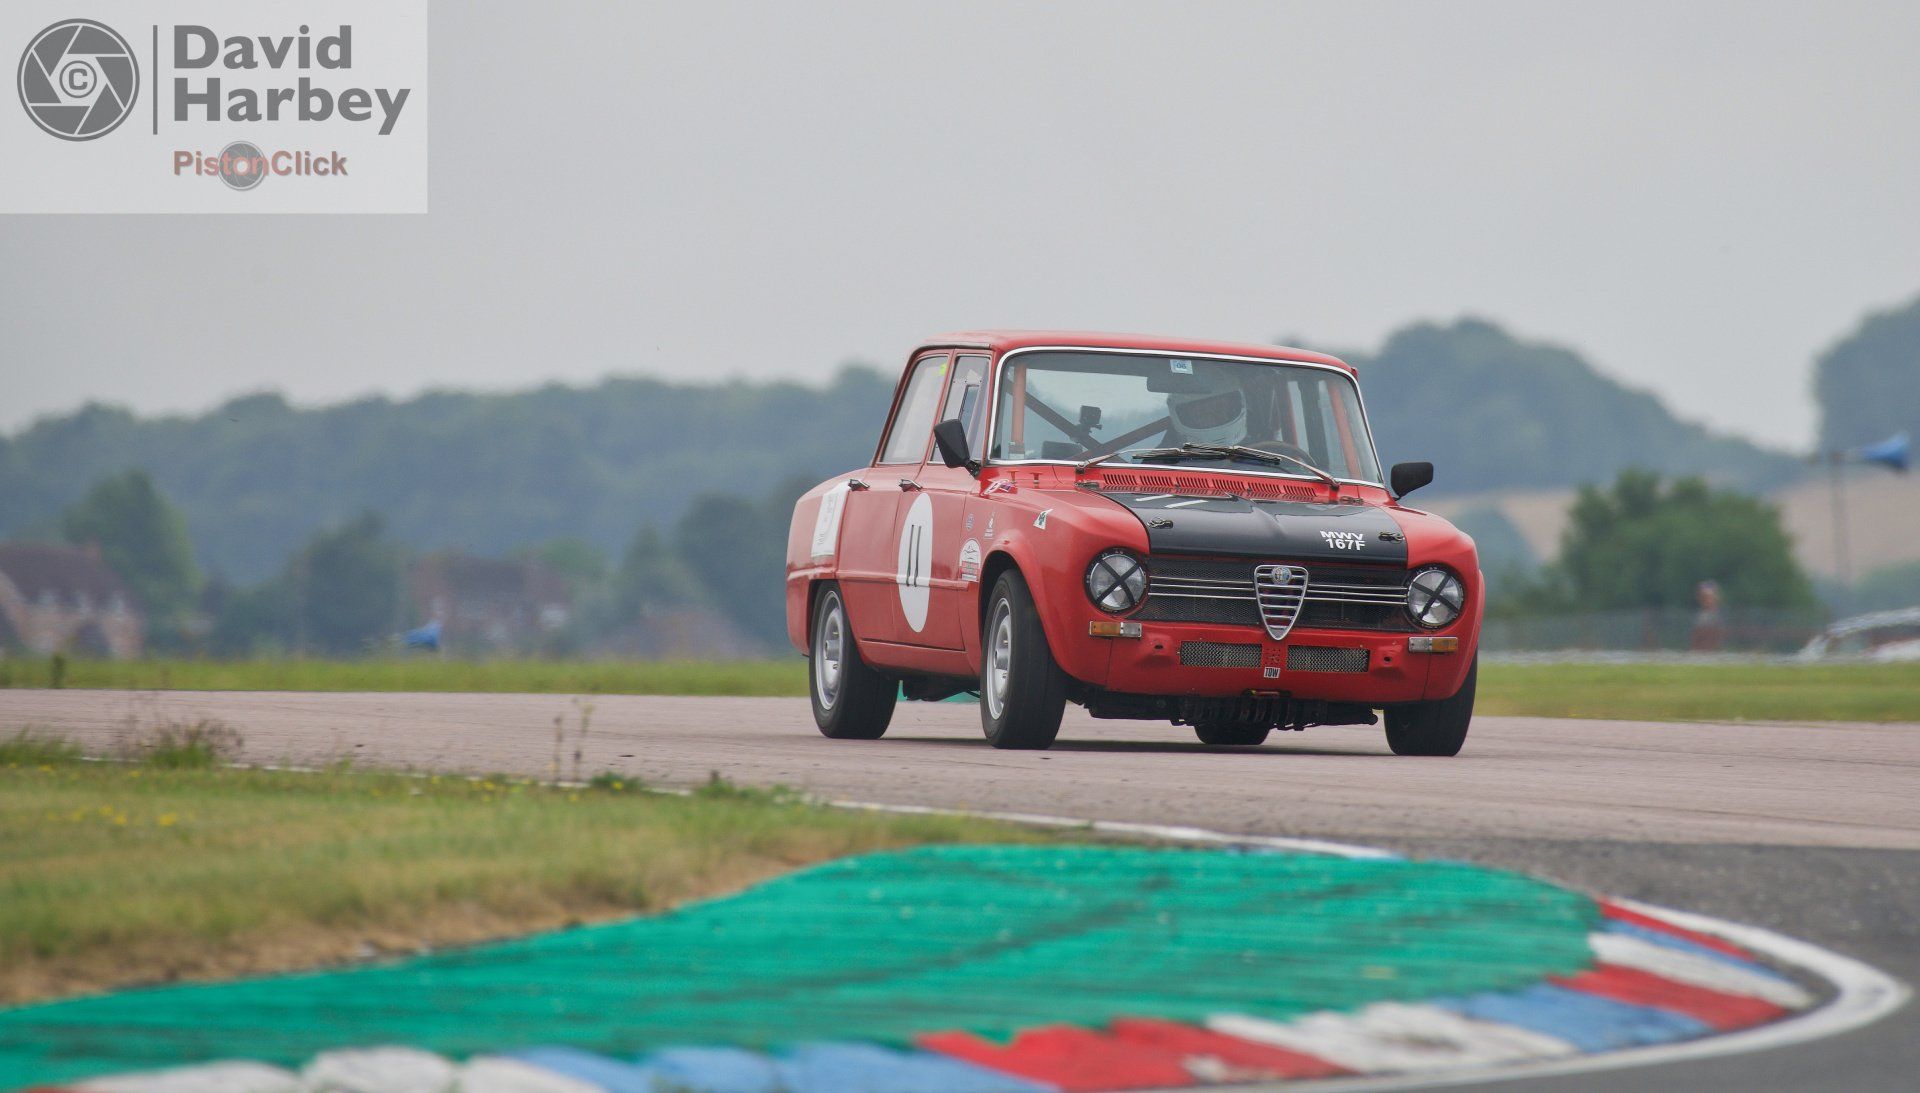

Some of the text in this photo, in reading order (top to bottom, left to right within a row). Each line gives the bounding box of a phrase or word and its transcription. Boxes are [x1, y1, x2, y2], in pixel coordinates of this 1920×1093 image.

[1320, 530, 1364, 541] MWV
[1325, 539, 1366, 551] 167F
[906, 524, 922, 588] 11
[1265, 667, 1280, 678] TOW
